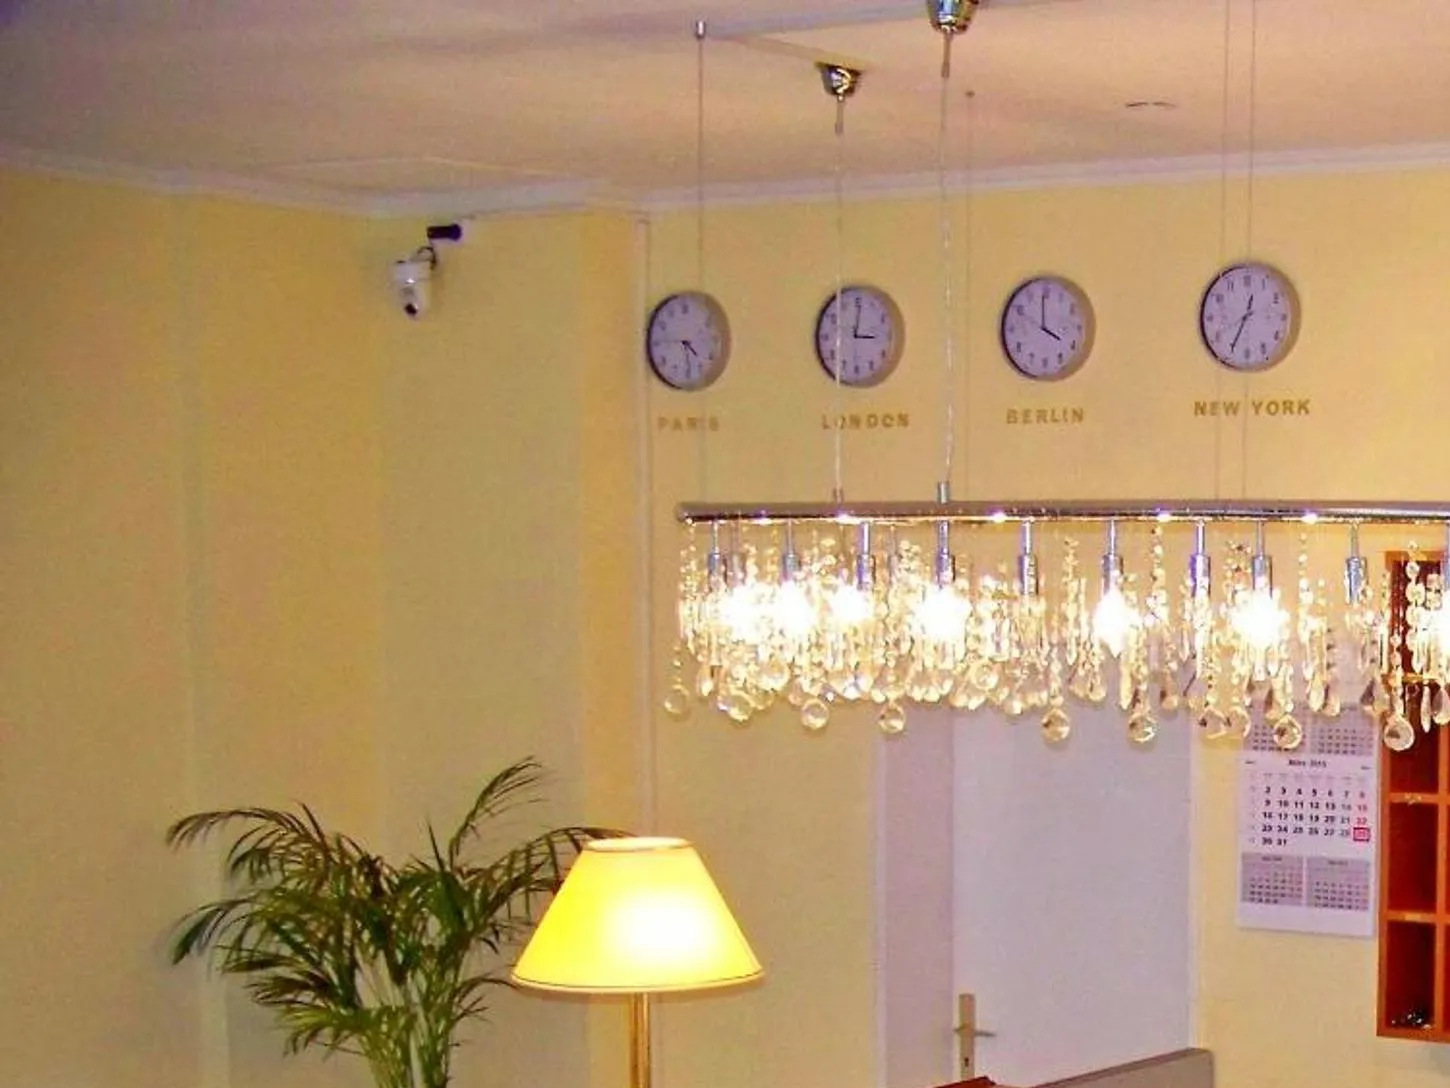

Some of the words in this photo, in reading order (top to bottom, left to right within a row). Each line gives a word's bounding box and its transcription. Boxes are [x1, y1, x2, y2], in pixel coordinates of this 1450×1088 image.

[1006, 408, 1084, 424] BERLIN
[1193, 401, 1240, 416] NEW
[1251, 400, 1310, 416] YORK
[657, 417, 719, 431] PARS
